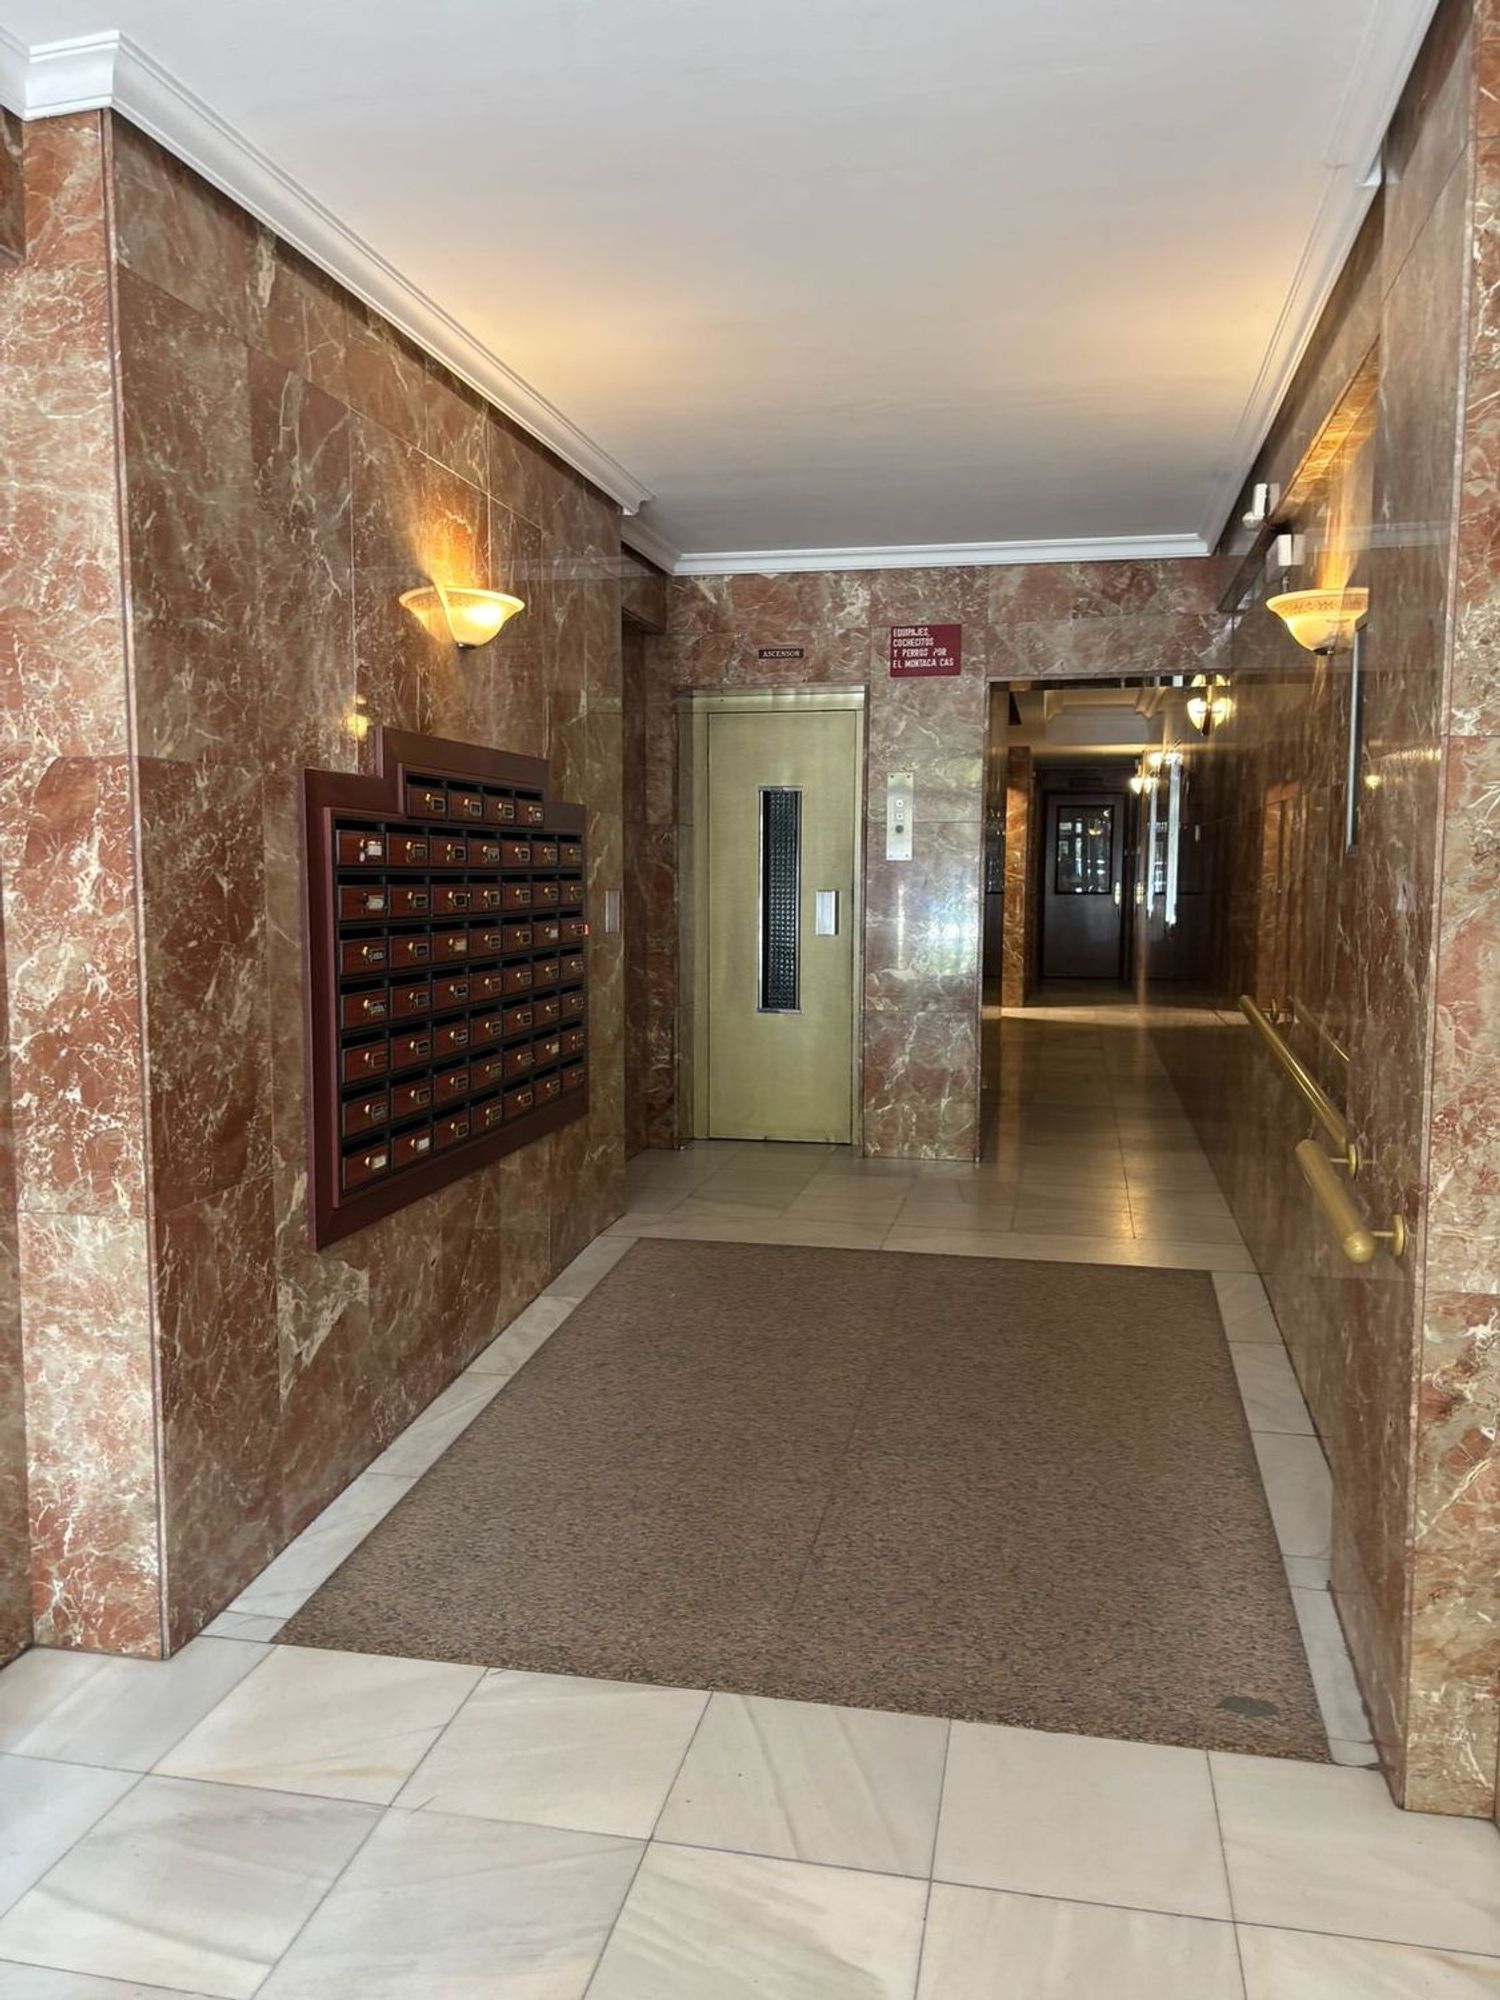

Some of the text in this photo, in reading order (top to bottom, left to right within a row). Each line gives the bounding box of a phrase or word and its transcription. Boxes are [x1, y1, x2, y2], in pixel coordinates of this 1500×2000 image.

[893, 638, 934, 647] COCHECITOS
[762, 649, 800, 658] ASCENSOR
[893, 647, 947, 658] Y PERROS POR
[892, 660, 901, 669] EL
